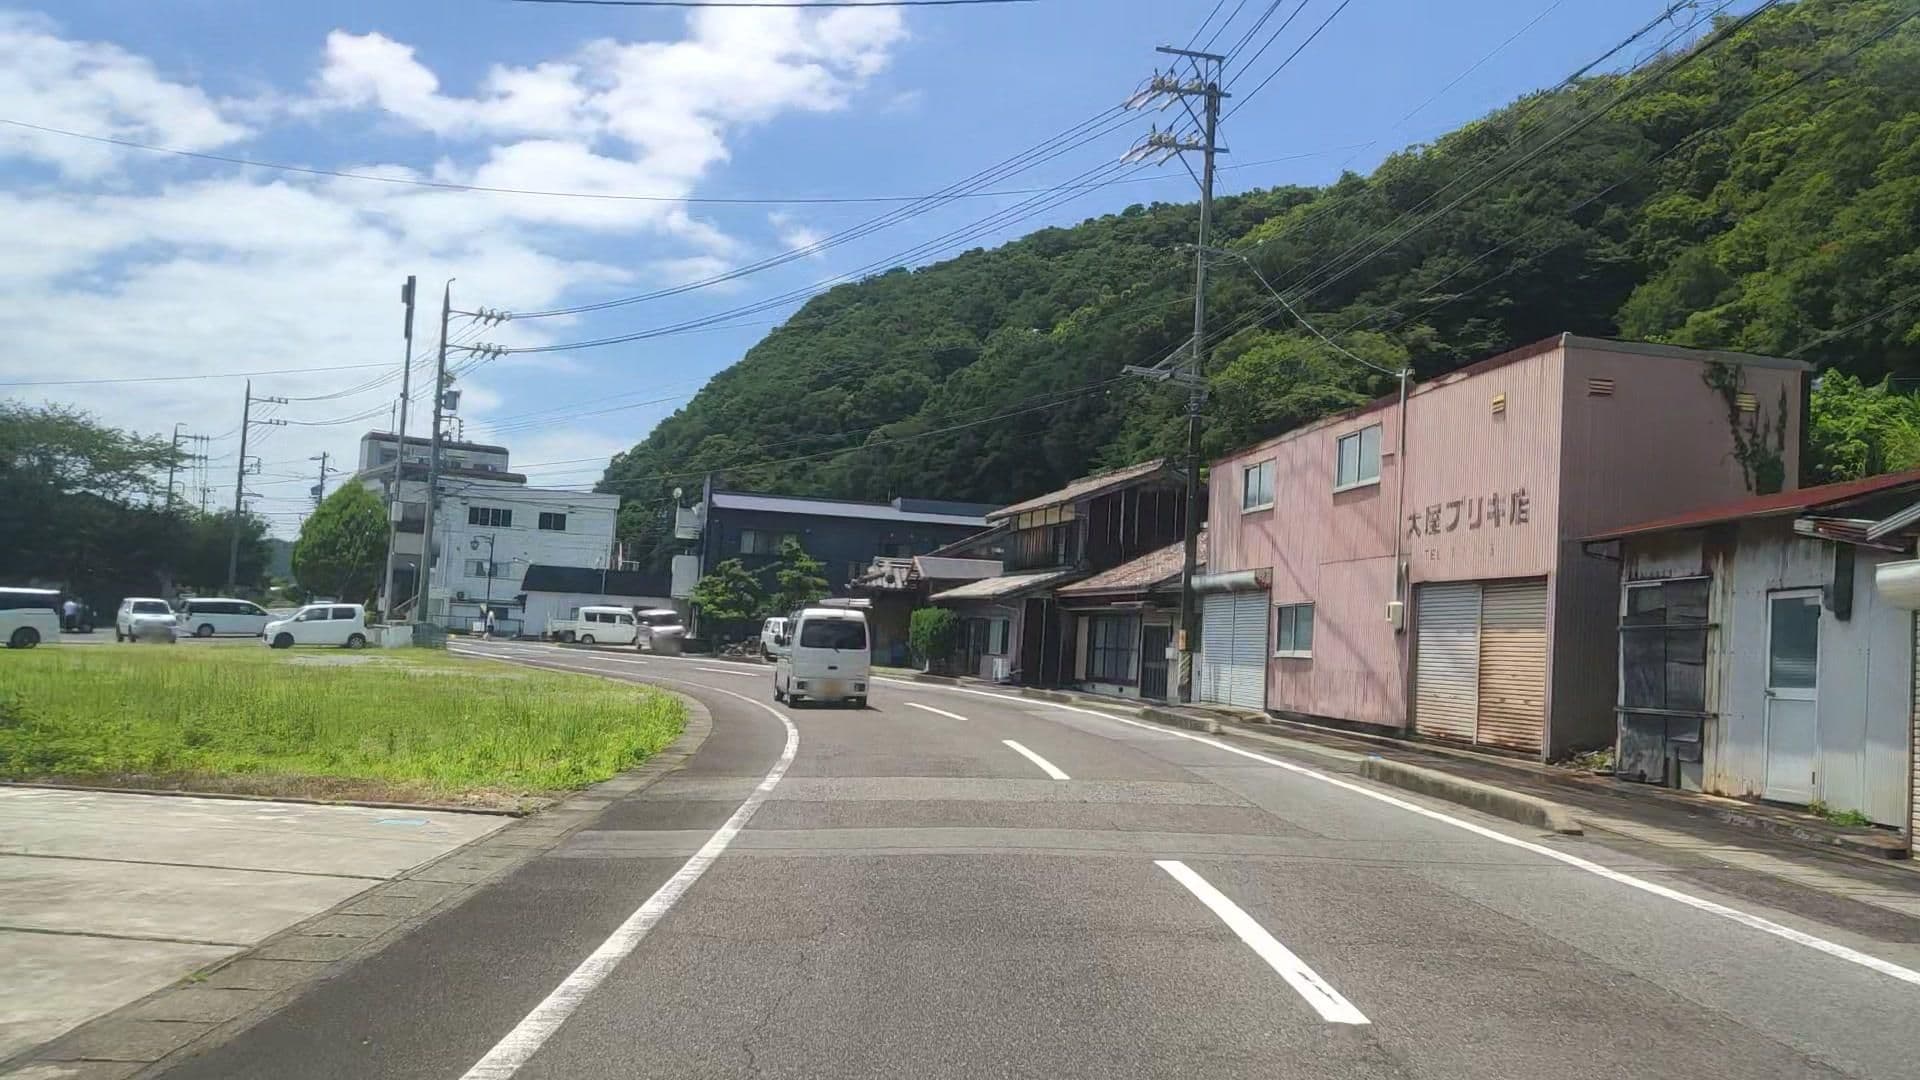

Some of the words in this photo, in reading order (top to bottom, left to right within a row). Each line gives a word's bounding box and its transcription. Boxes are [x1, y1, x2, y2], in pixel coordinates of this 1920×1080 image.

[1407, 488, 1530, 539] 大屋ブリキ店
